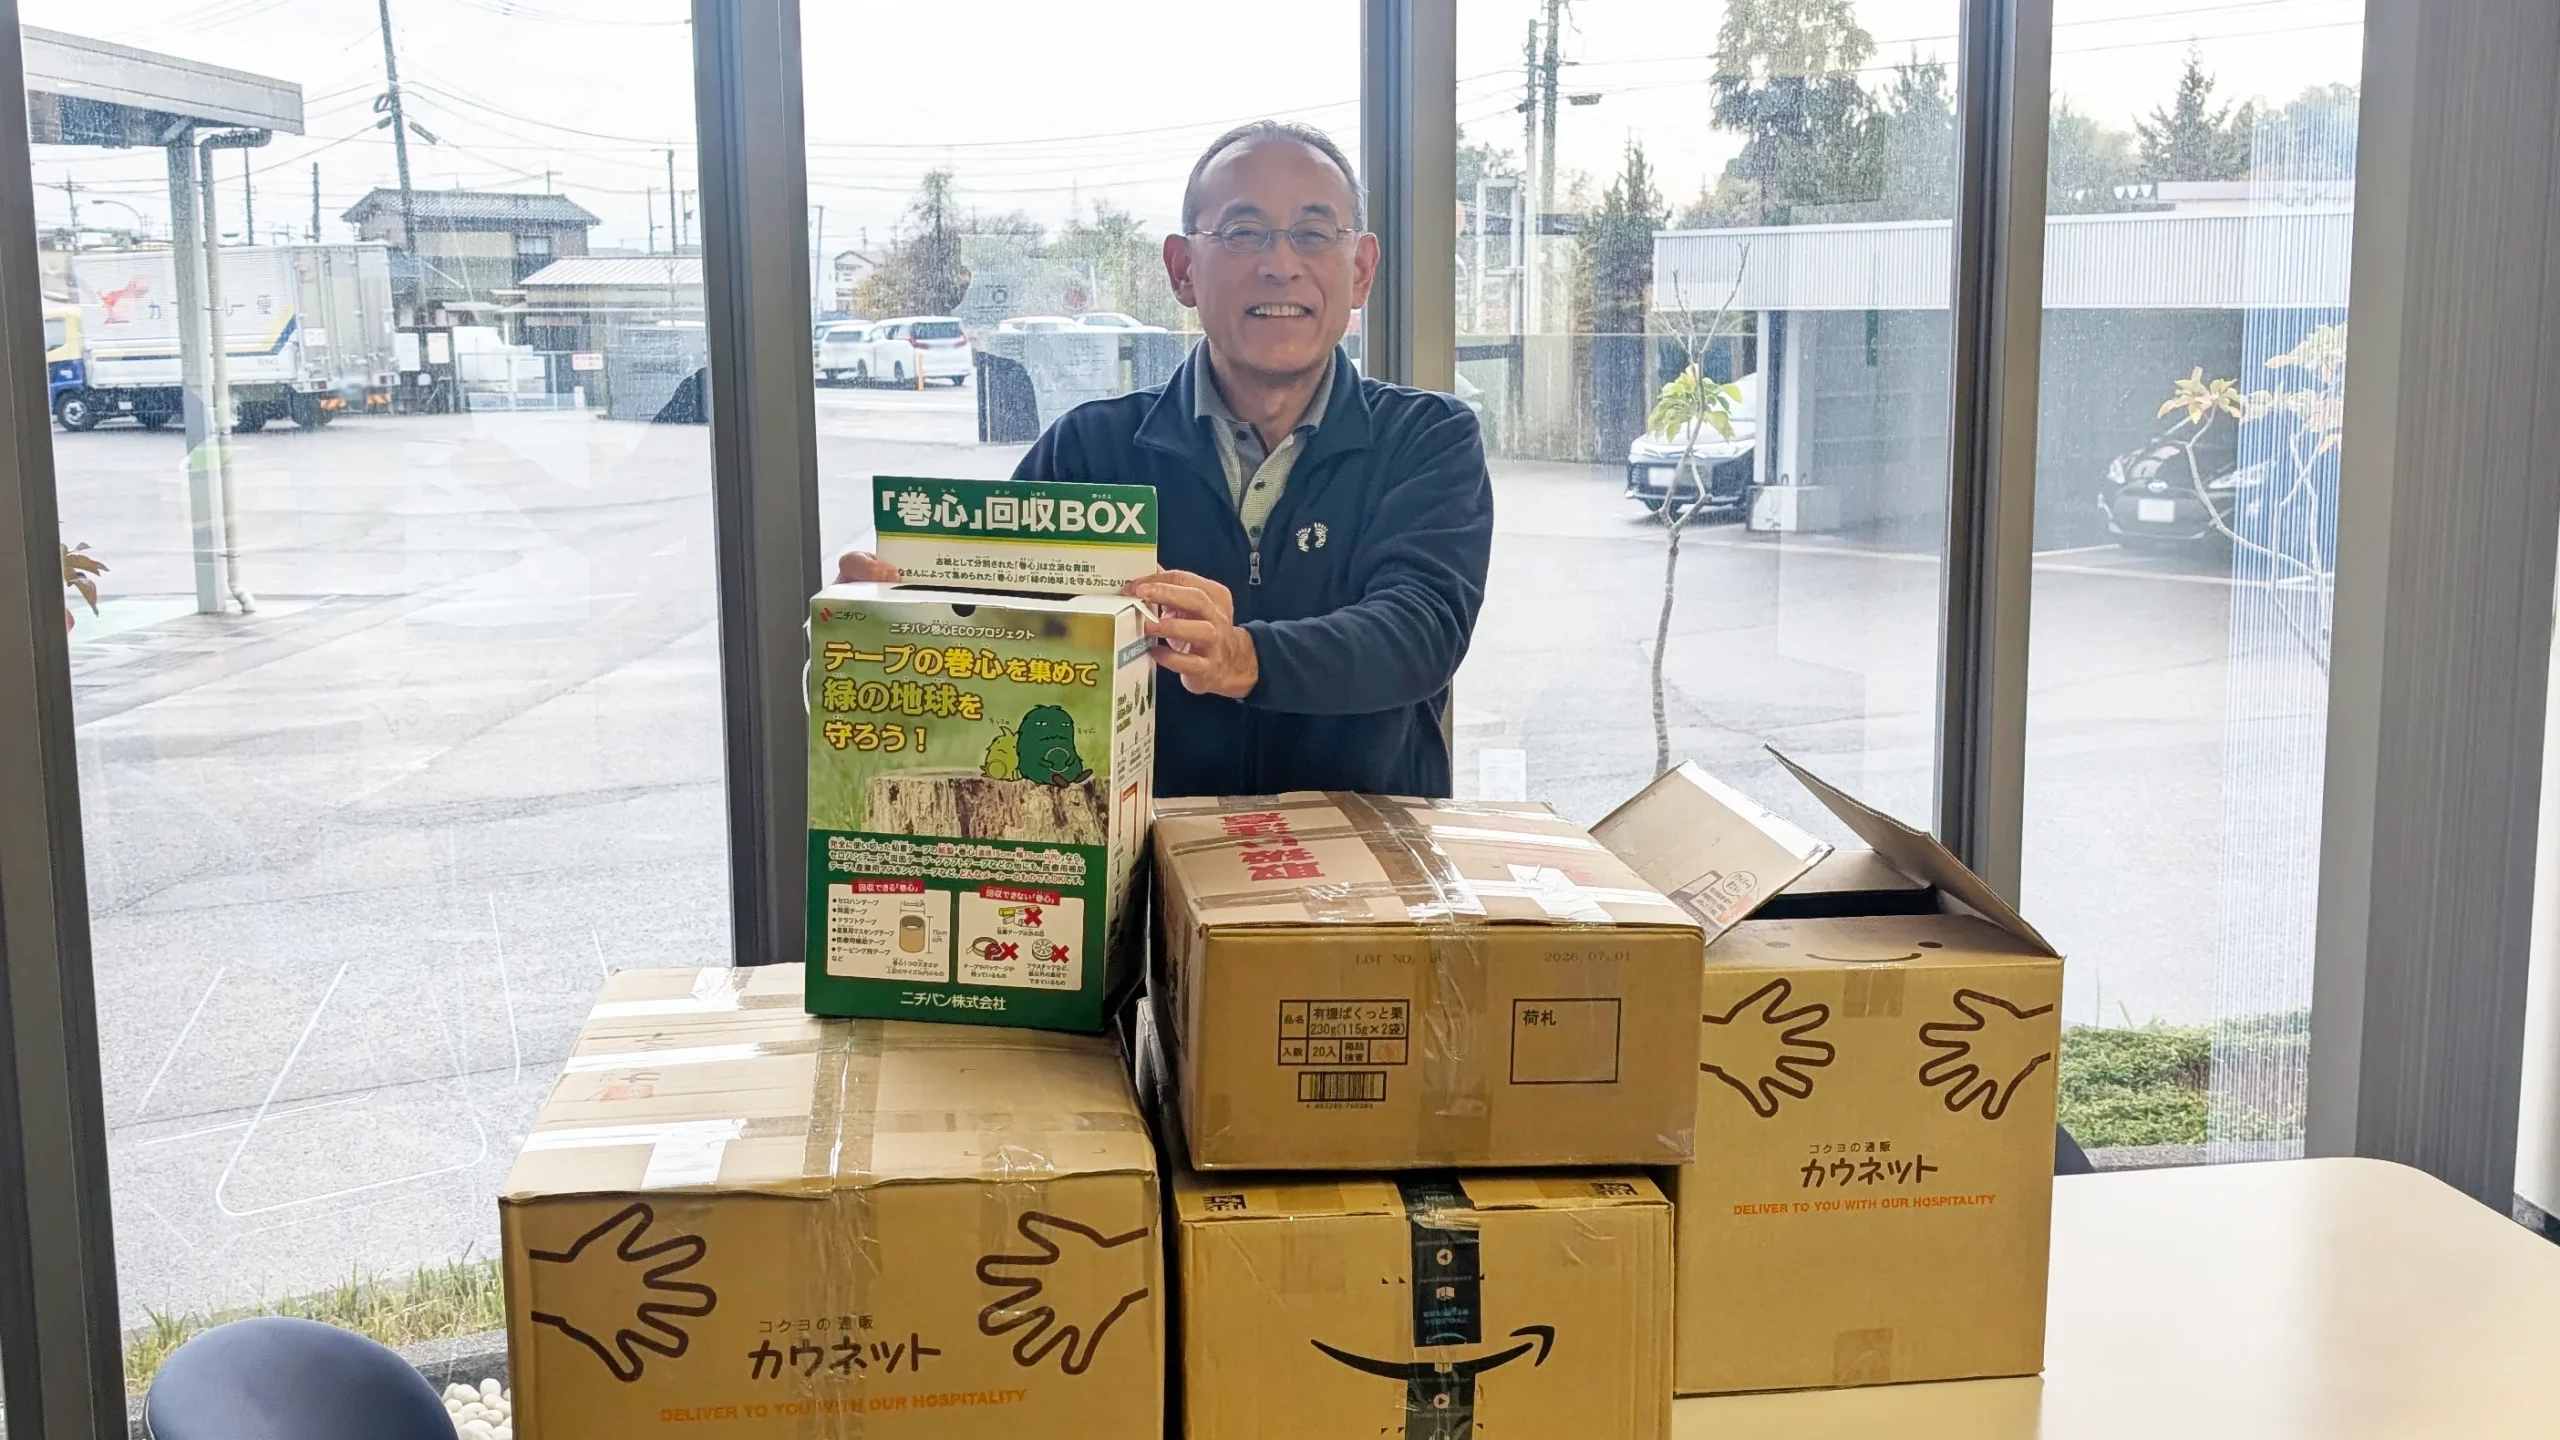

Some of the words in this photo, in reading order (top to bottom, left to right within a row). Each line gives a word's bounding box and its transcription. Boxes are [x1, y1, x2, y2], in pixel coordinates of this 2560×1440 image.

[882, 490, 1147, 535] 「巻心」回収BOX
[835, 611, 867, 621] ニチバン
[890, 622, 1036, 640] ニチバン巻心ECOプロジェクト
[824, 641, 1099, 686] テープの巻心を集めて
[822, 677, 984, 720] 緑の地球を
[900, 991, 1006, 1011] ニチバン株式会社
[1284, 1014, 1304, 1025] 品名
[1523, 1009, 1556, 1026] 荷札
[1282, 1047, 1303, 1057] 入数
[1312, 1046, 1337, 1058] 20入
[1809, 1141, 1891, 1154] コクヨの通販
[1801, 1154, 1938, 1188] カウネット
[1733, 1202, 1788, 1215] DELIVER
[1793, 1202, 1809, 1213] TO
[1814, 1200, 1840, 1212] YOU
[1845, 1199, 1877, 1211] WITH
[1881, 1198, 1909, 1209] OUR
[1913, 1194, 1997, 1208] HOSPITALITY
[759, 1315, 874, 1334] コクヨの通販
[748, 1333, 941, 1379] カウネット
[660, 1407, 738, 1422] DELIVER
[744, 1405, 768, 1418] TO
[775, 1403, 810, 1417] YOU
[869, 1396, 909, 1411] OUR
[912, 1388, 1029, 1409] HOSPITALITY
